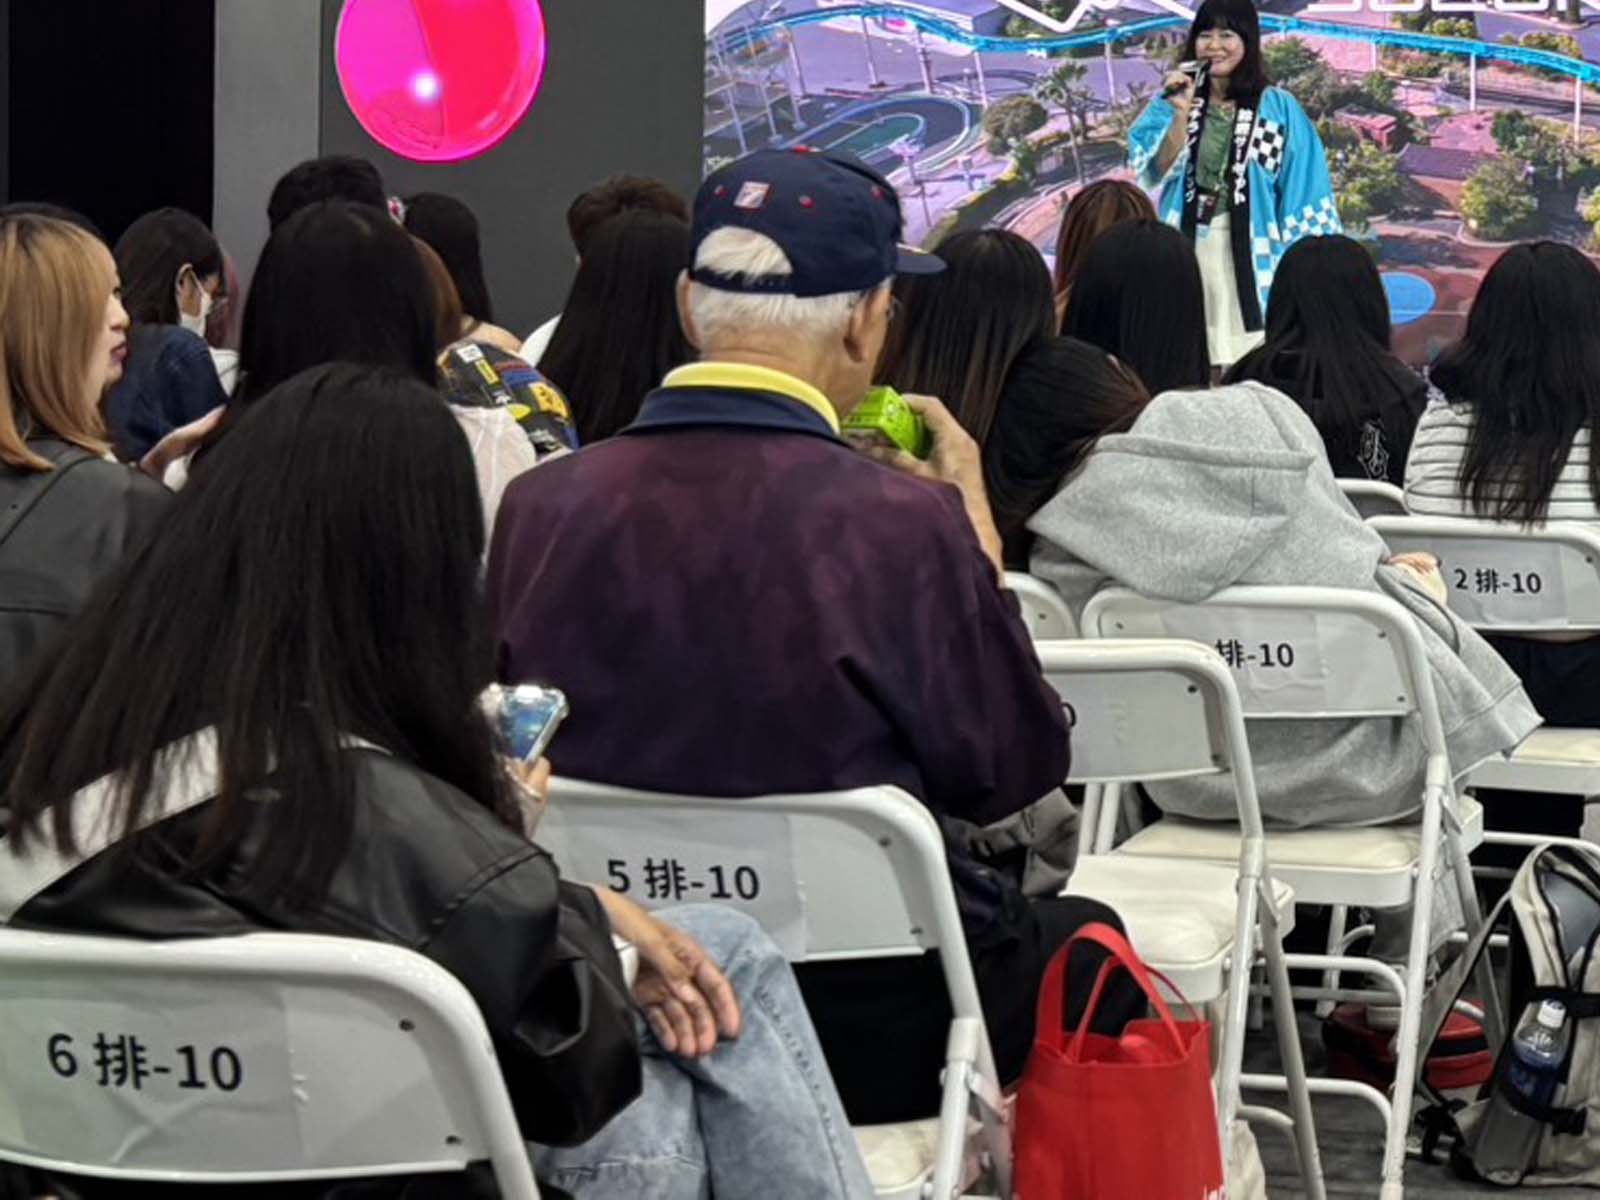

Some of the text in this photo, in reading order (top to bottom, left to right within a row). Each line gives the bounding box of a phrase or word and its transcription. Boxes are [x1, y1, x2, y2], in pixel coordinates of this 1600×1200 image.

[1454, 568, 1542, 594] 2 排-10
[607, 858, 759, 901] 5 排-10
[47, 1032, 243, 1092] 6 排-10
